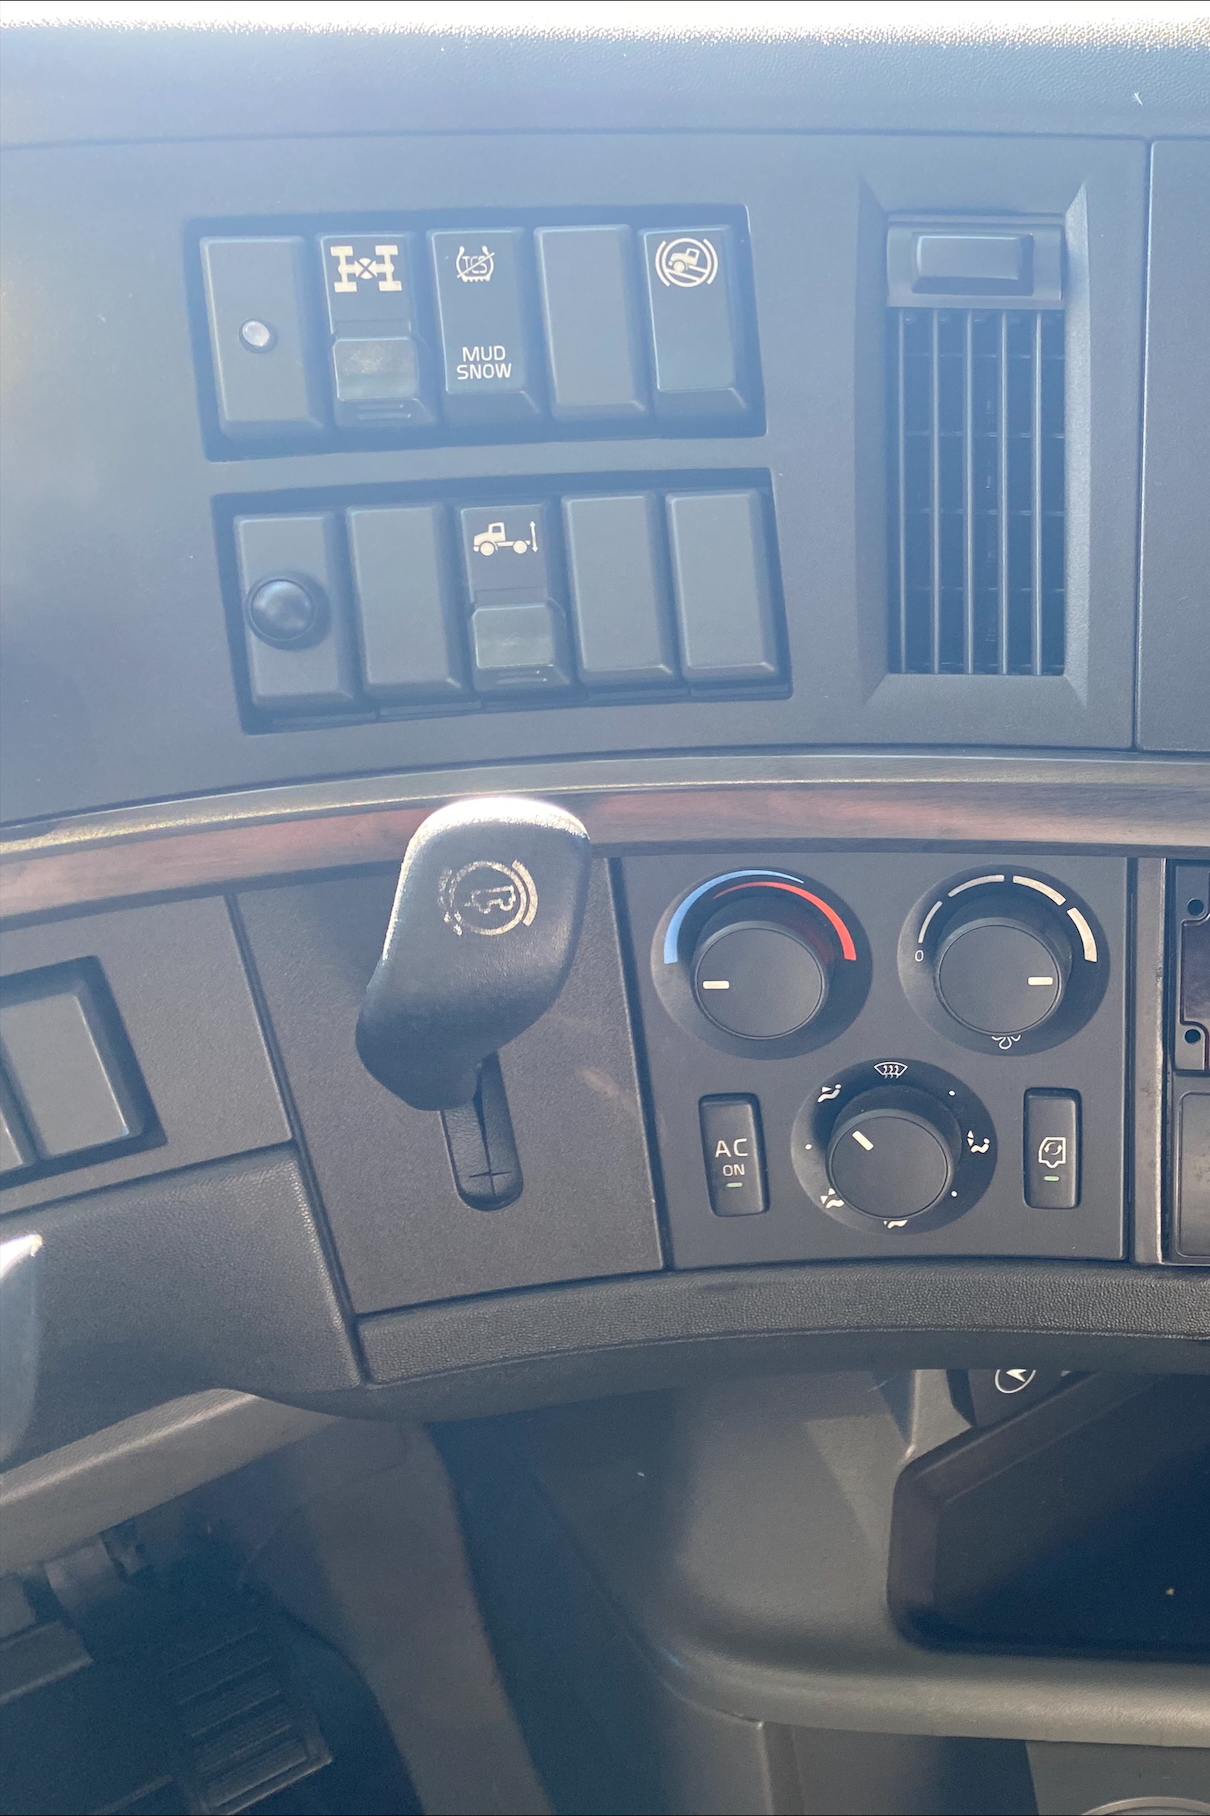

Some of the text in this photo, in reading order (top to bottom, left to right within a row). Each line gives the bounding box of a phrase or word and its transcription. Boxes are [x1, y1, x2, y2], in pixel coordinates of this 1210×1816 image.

[462, 345, 506, 362] MUD
[456, 363, 512, 380] SNOW
[714, 1138, 749, 1158] AC
[722, 1163, 746, 1177] ON
